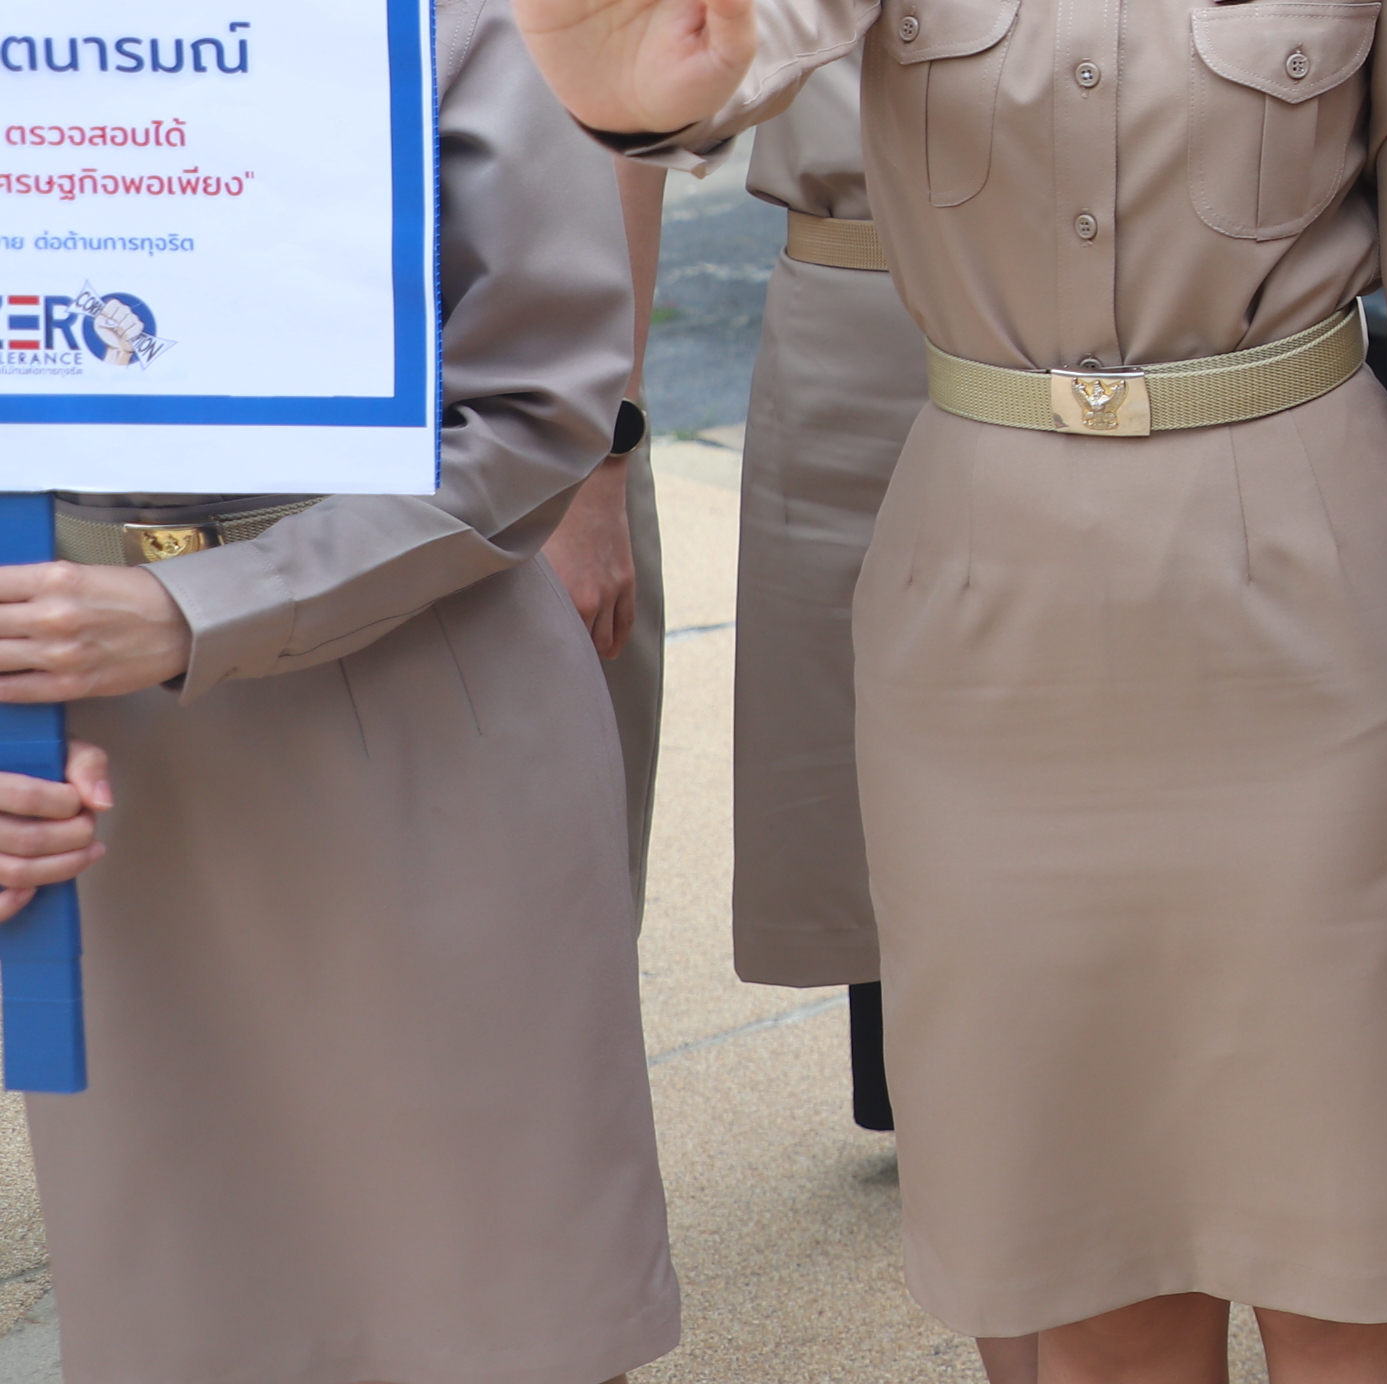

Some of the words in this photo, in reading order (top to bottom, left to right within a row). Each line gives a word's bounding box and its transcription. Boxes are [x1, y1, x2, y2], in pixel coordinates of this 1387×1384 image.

[4, 117, 187, 148] ตรวจสอบได้
[34, 229, 195, 256] ต่อต้านการทุจริต
[0, 292, 157, 367] ERO
